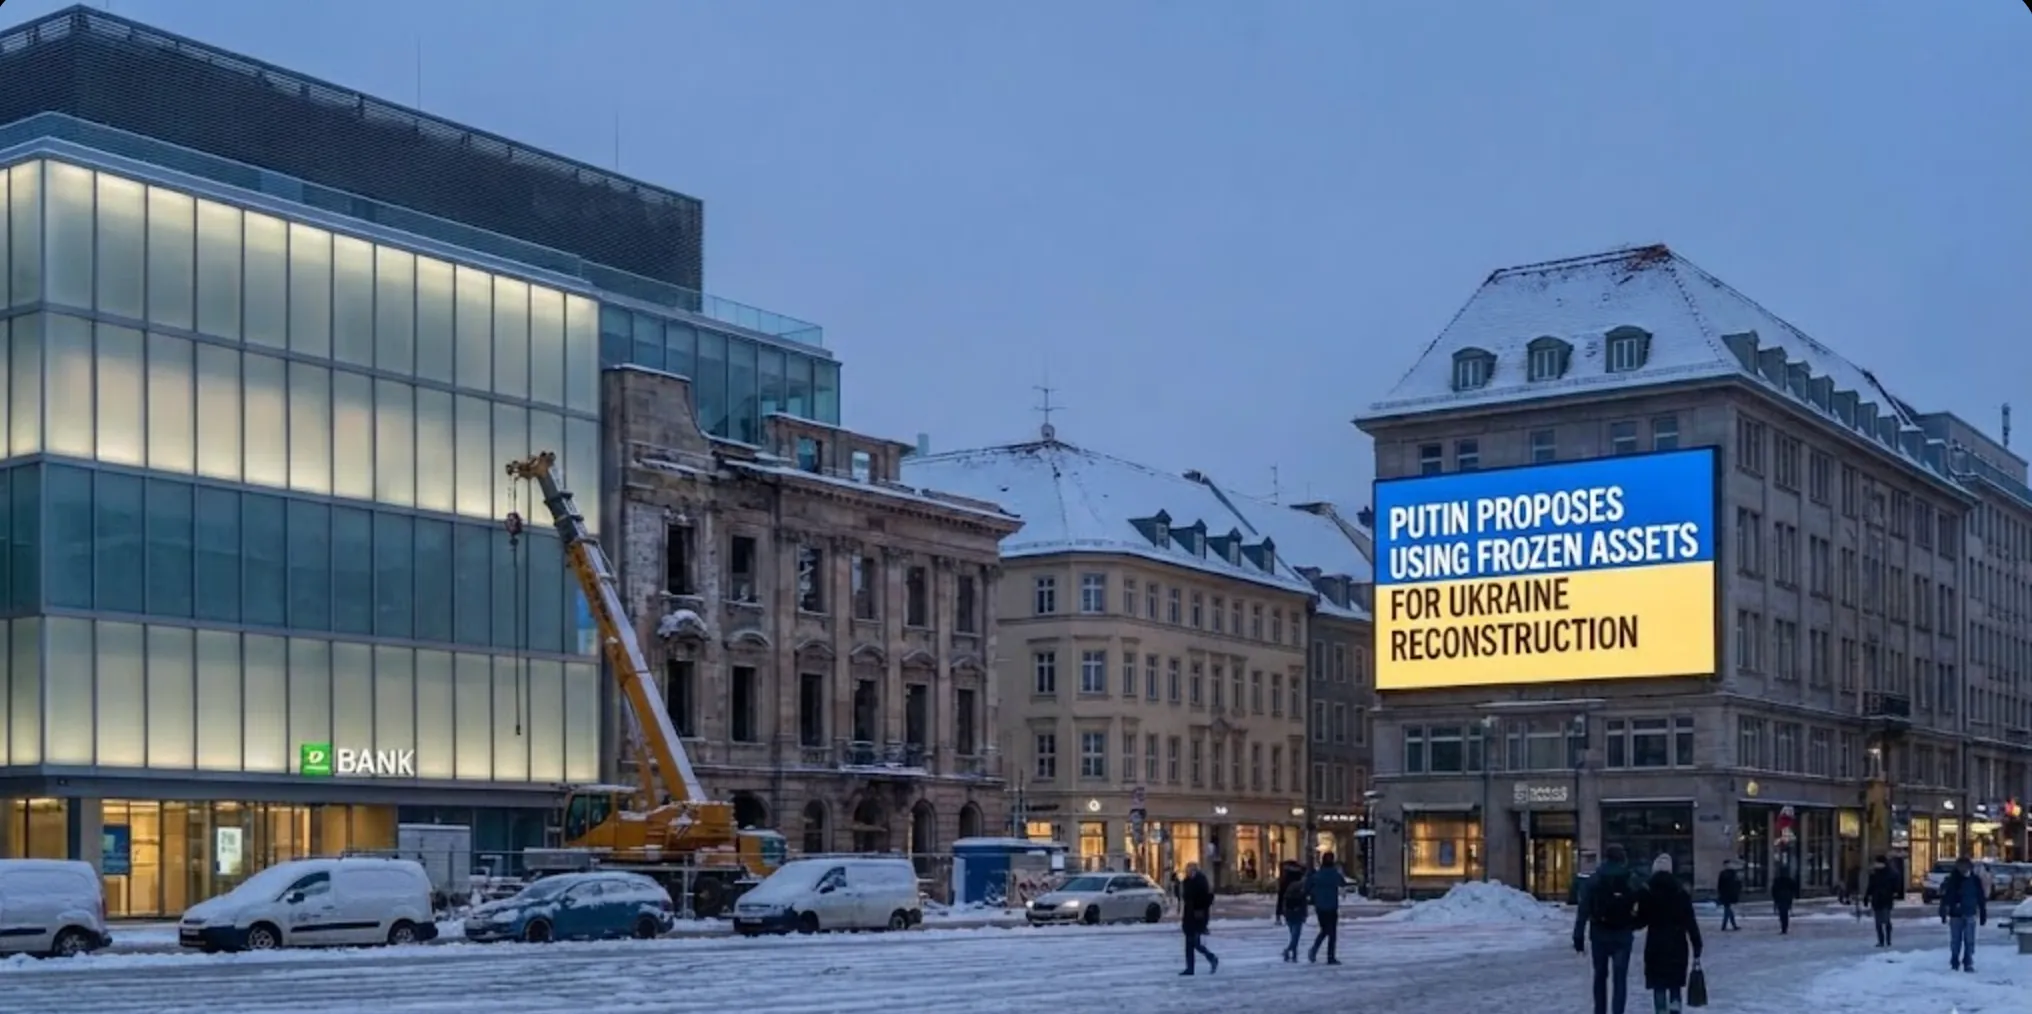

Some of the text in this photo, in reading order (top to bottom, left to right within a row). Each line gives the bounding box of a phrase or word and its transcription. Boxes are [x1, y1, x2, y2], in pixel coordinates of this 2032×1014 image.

[1390, 486, 1624, 540] PUTIN PROPOSES
[1391, 523, 1698, 579] USING FROZEN ASSETS
[1391, 578, 1569, 620] FOR UKRAINE
[1391, 616, 1638, 661] RECONSTRUCTION
[338, 748, 415, 776] BANK
